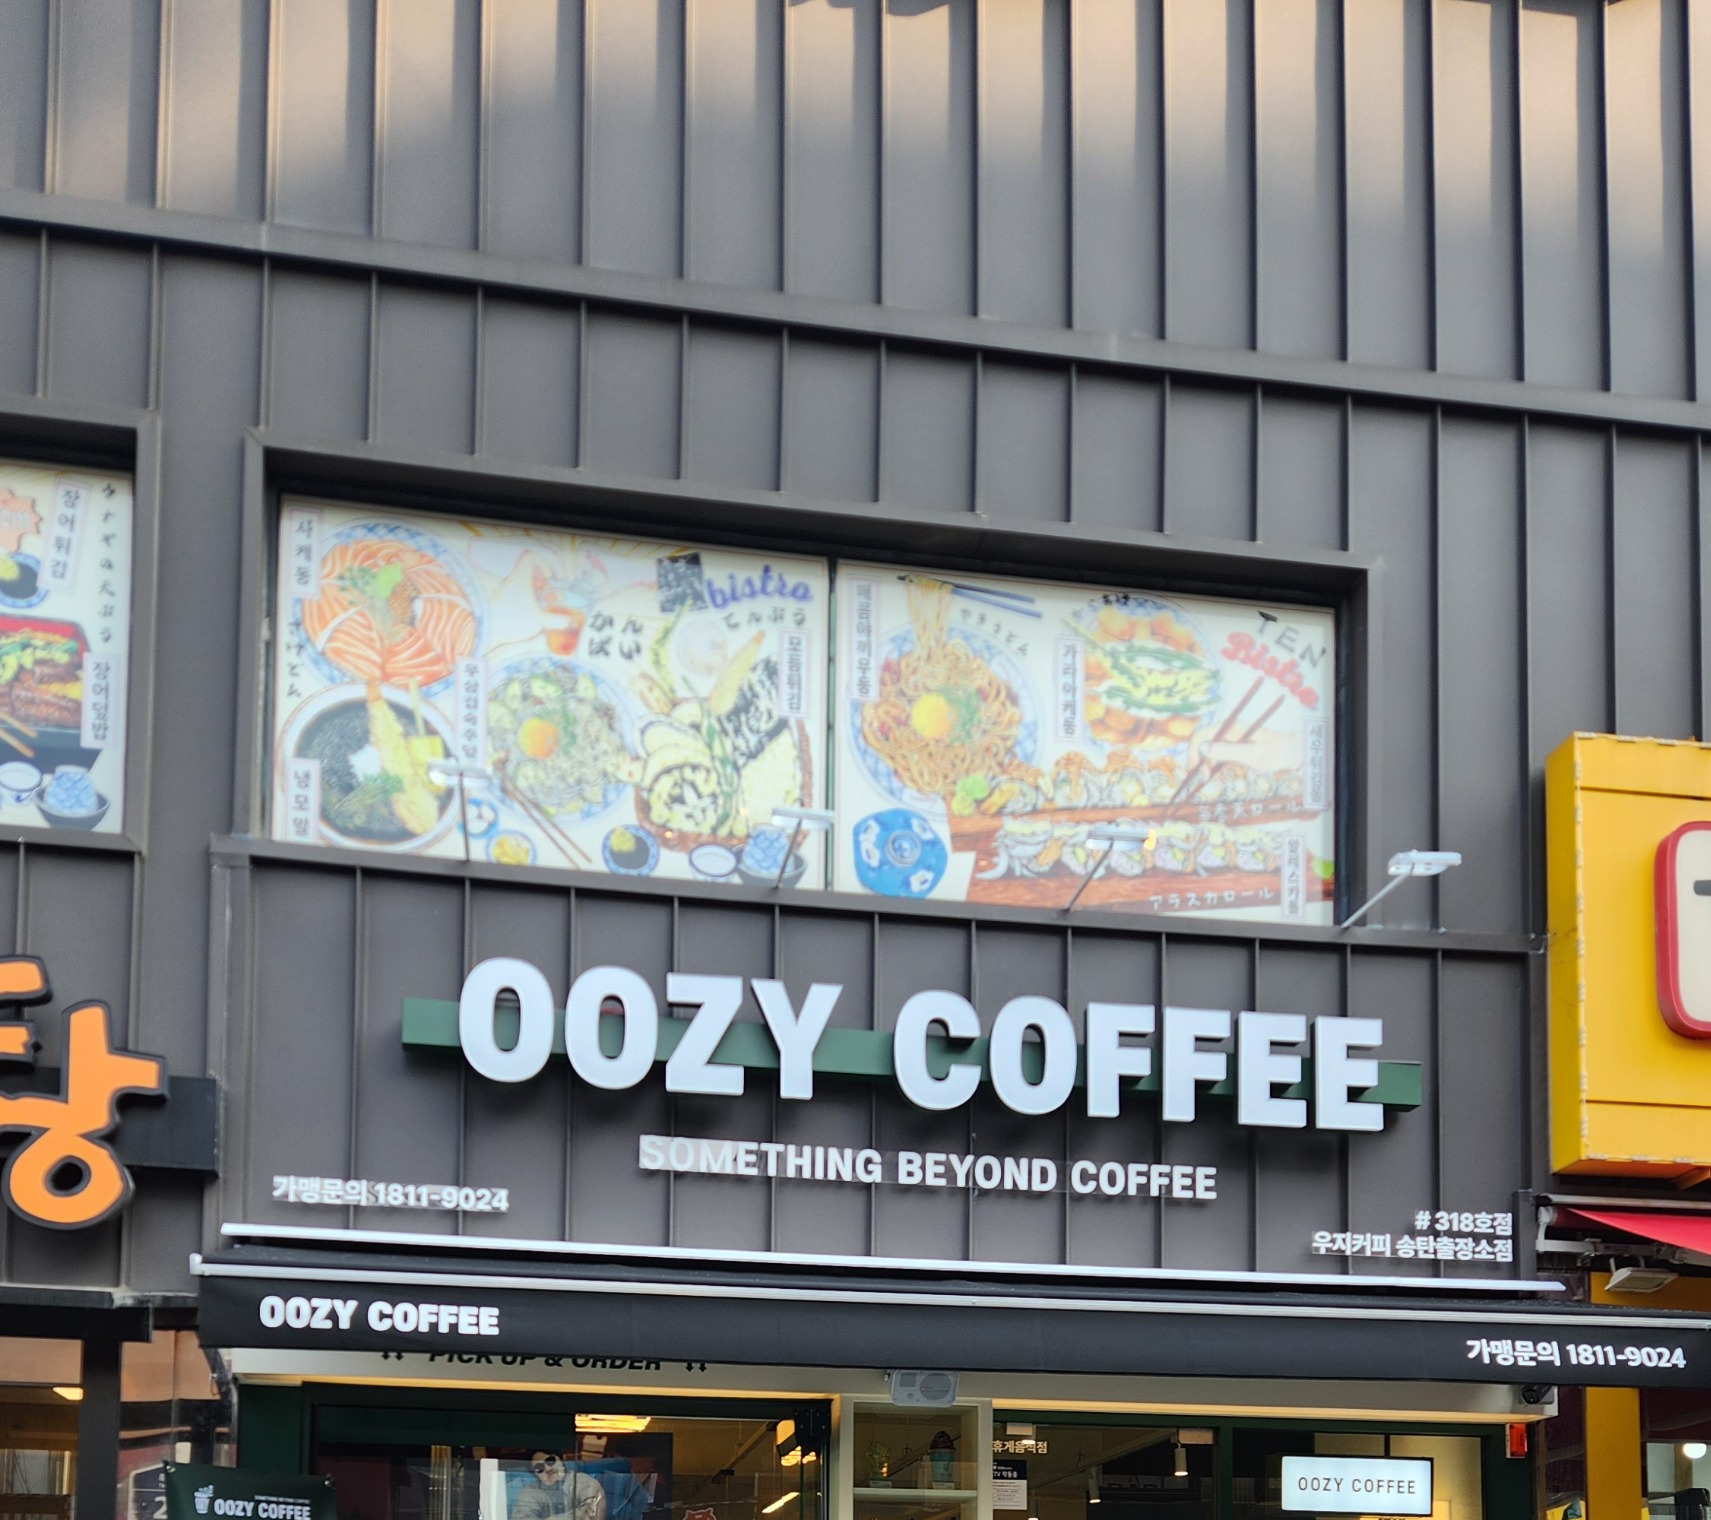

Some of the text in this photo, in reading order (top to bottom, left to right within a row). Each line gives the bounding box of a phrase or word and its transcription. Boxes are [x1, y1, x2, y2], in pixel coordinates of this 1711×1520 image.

[706, 564, 813, 608] bistro
[459, 957, 1386, 1132] OOZY COFFEE
[640, 1136, 1218, 1201] SOMETHING BEYOND COFFEE
[273, 1176, 509, 1213] 가맹문의 1811-9024
[1435, 1211, 1514, 1237] 318호점
[1312, 1231, 1514, 1263] 우지커피 송탄출장소점
[259, 1295, 500, 1337] OOZY COFFEE
[1466, 1338, 1687, 1370] 가맹문의 1811-9024
[1298, 1477, 1416, 1494] OOZY COFFEE
[214, 1498, 255, 1517] OOZY
